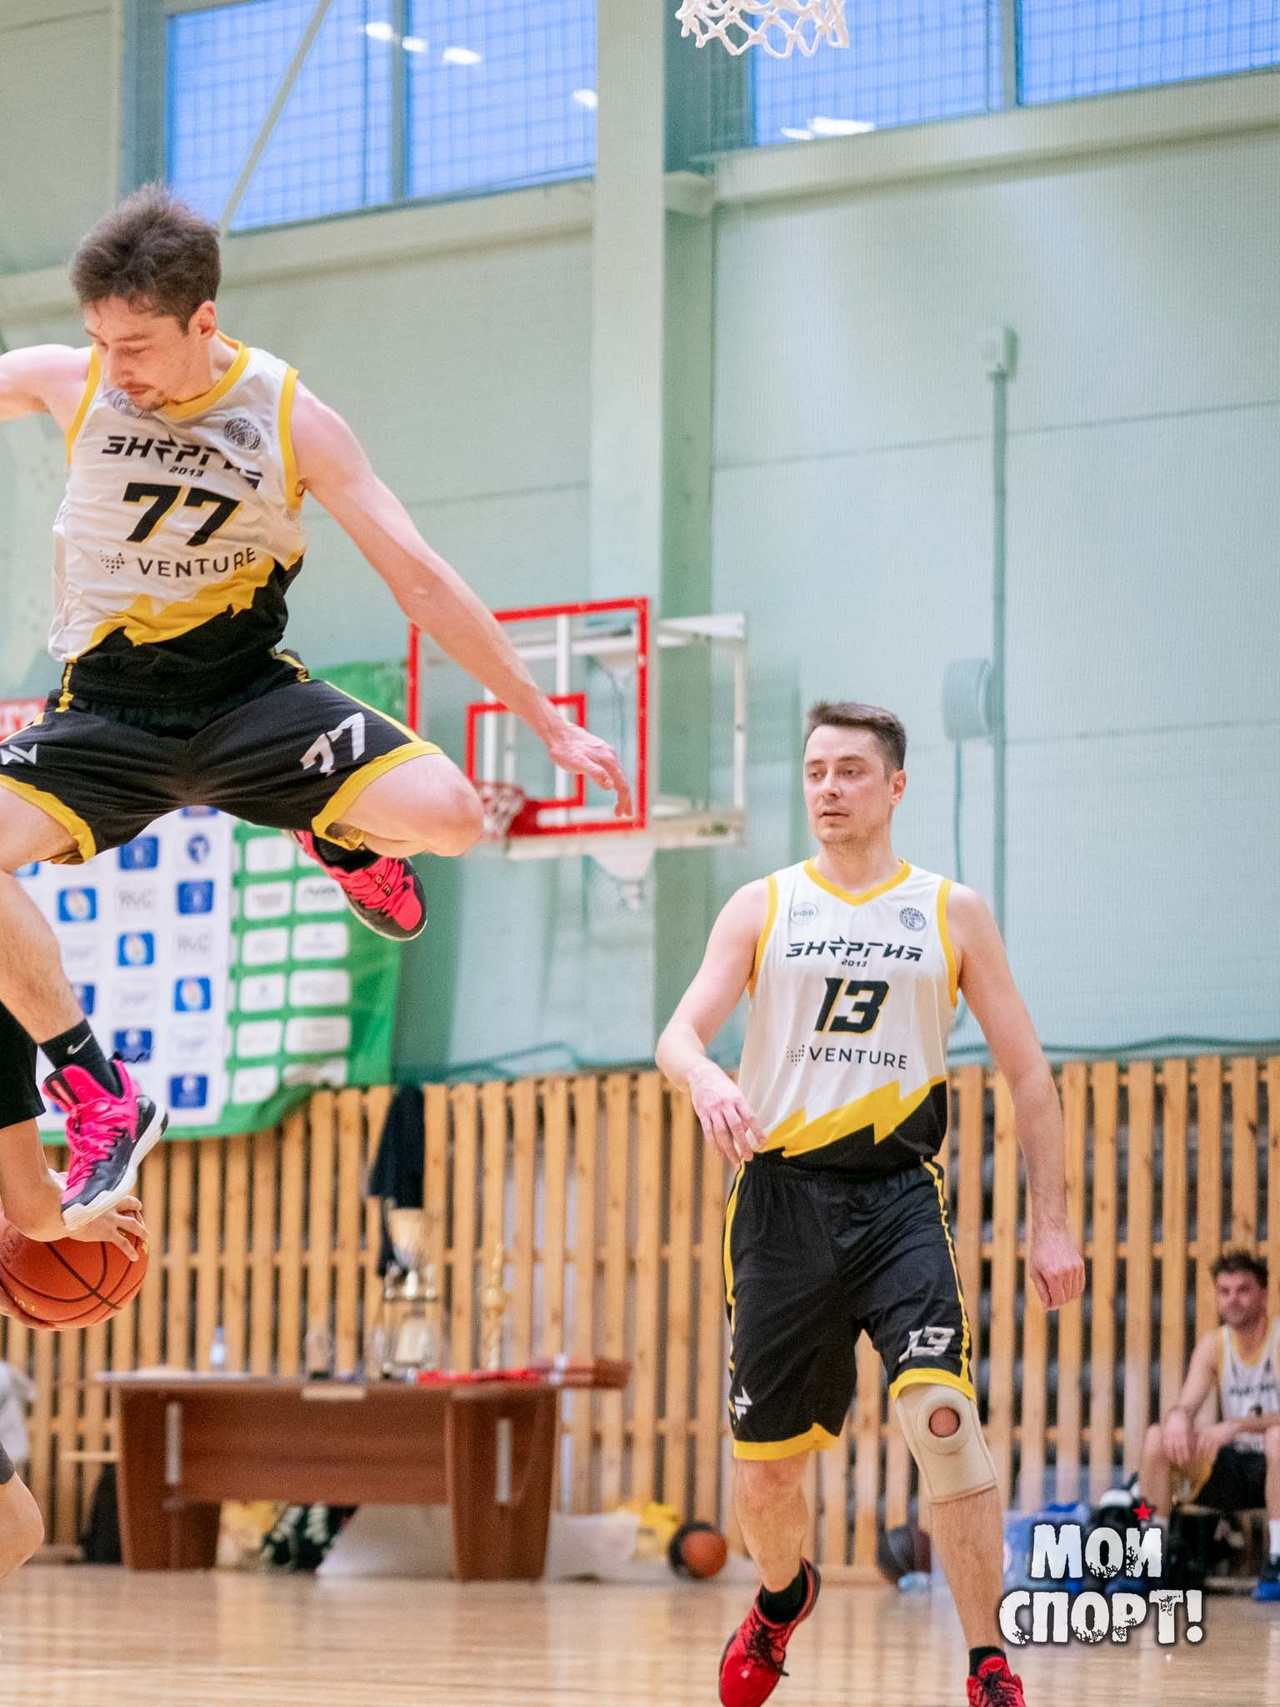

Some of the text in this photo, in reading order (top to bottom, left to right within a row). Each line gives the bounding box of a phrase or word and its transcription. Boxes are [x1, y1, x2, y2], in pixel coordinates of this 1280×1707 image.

[101, 434, 264, 491] ЭНЕРГЯ
[168, 467, 205, 478] 2013
[122, 482, 244, 547] 77
[137, 547, 257, 578] VENTURE
[300, 711, 366, 778] 77
[786, 934, 924, 962] ЭНЕРГИЯ
[840, 958, 867, 968] 2013
[814, 976, 890, 1035] 13
[809, 1047, 908, 1070] VENTURE
[898, 1325, 956, 1364] 13
